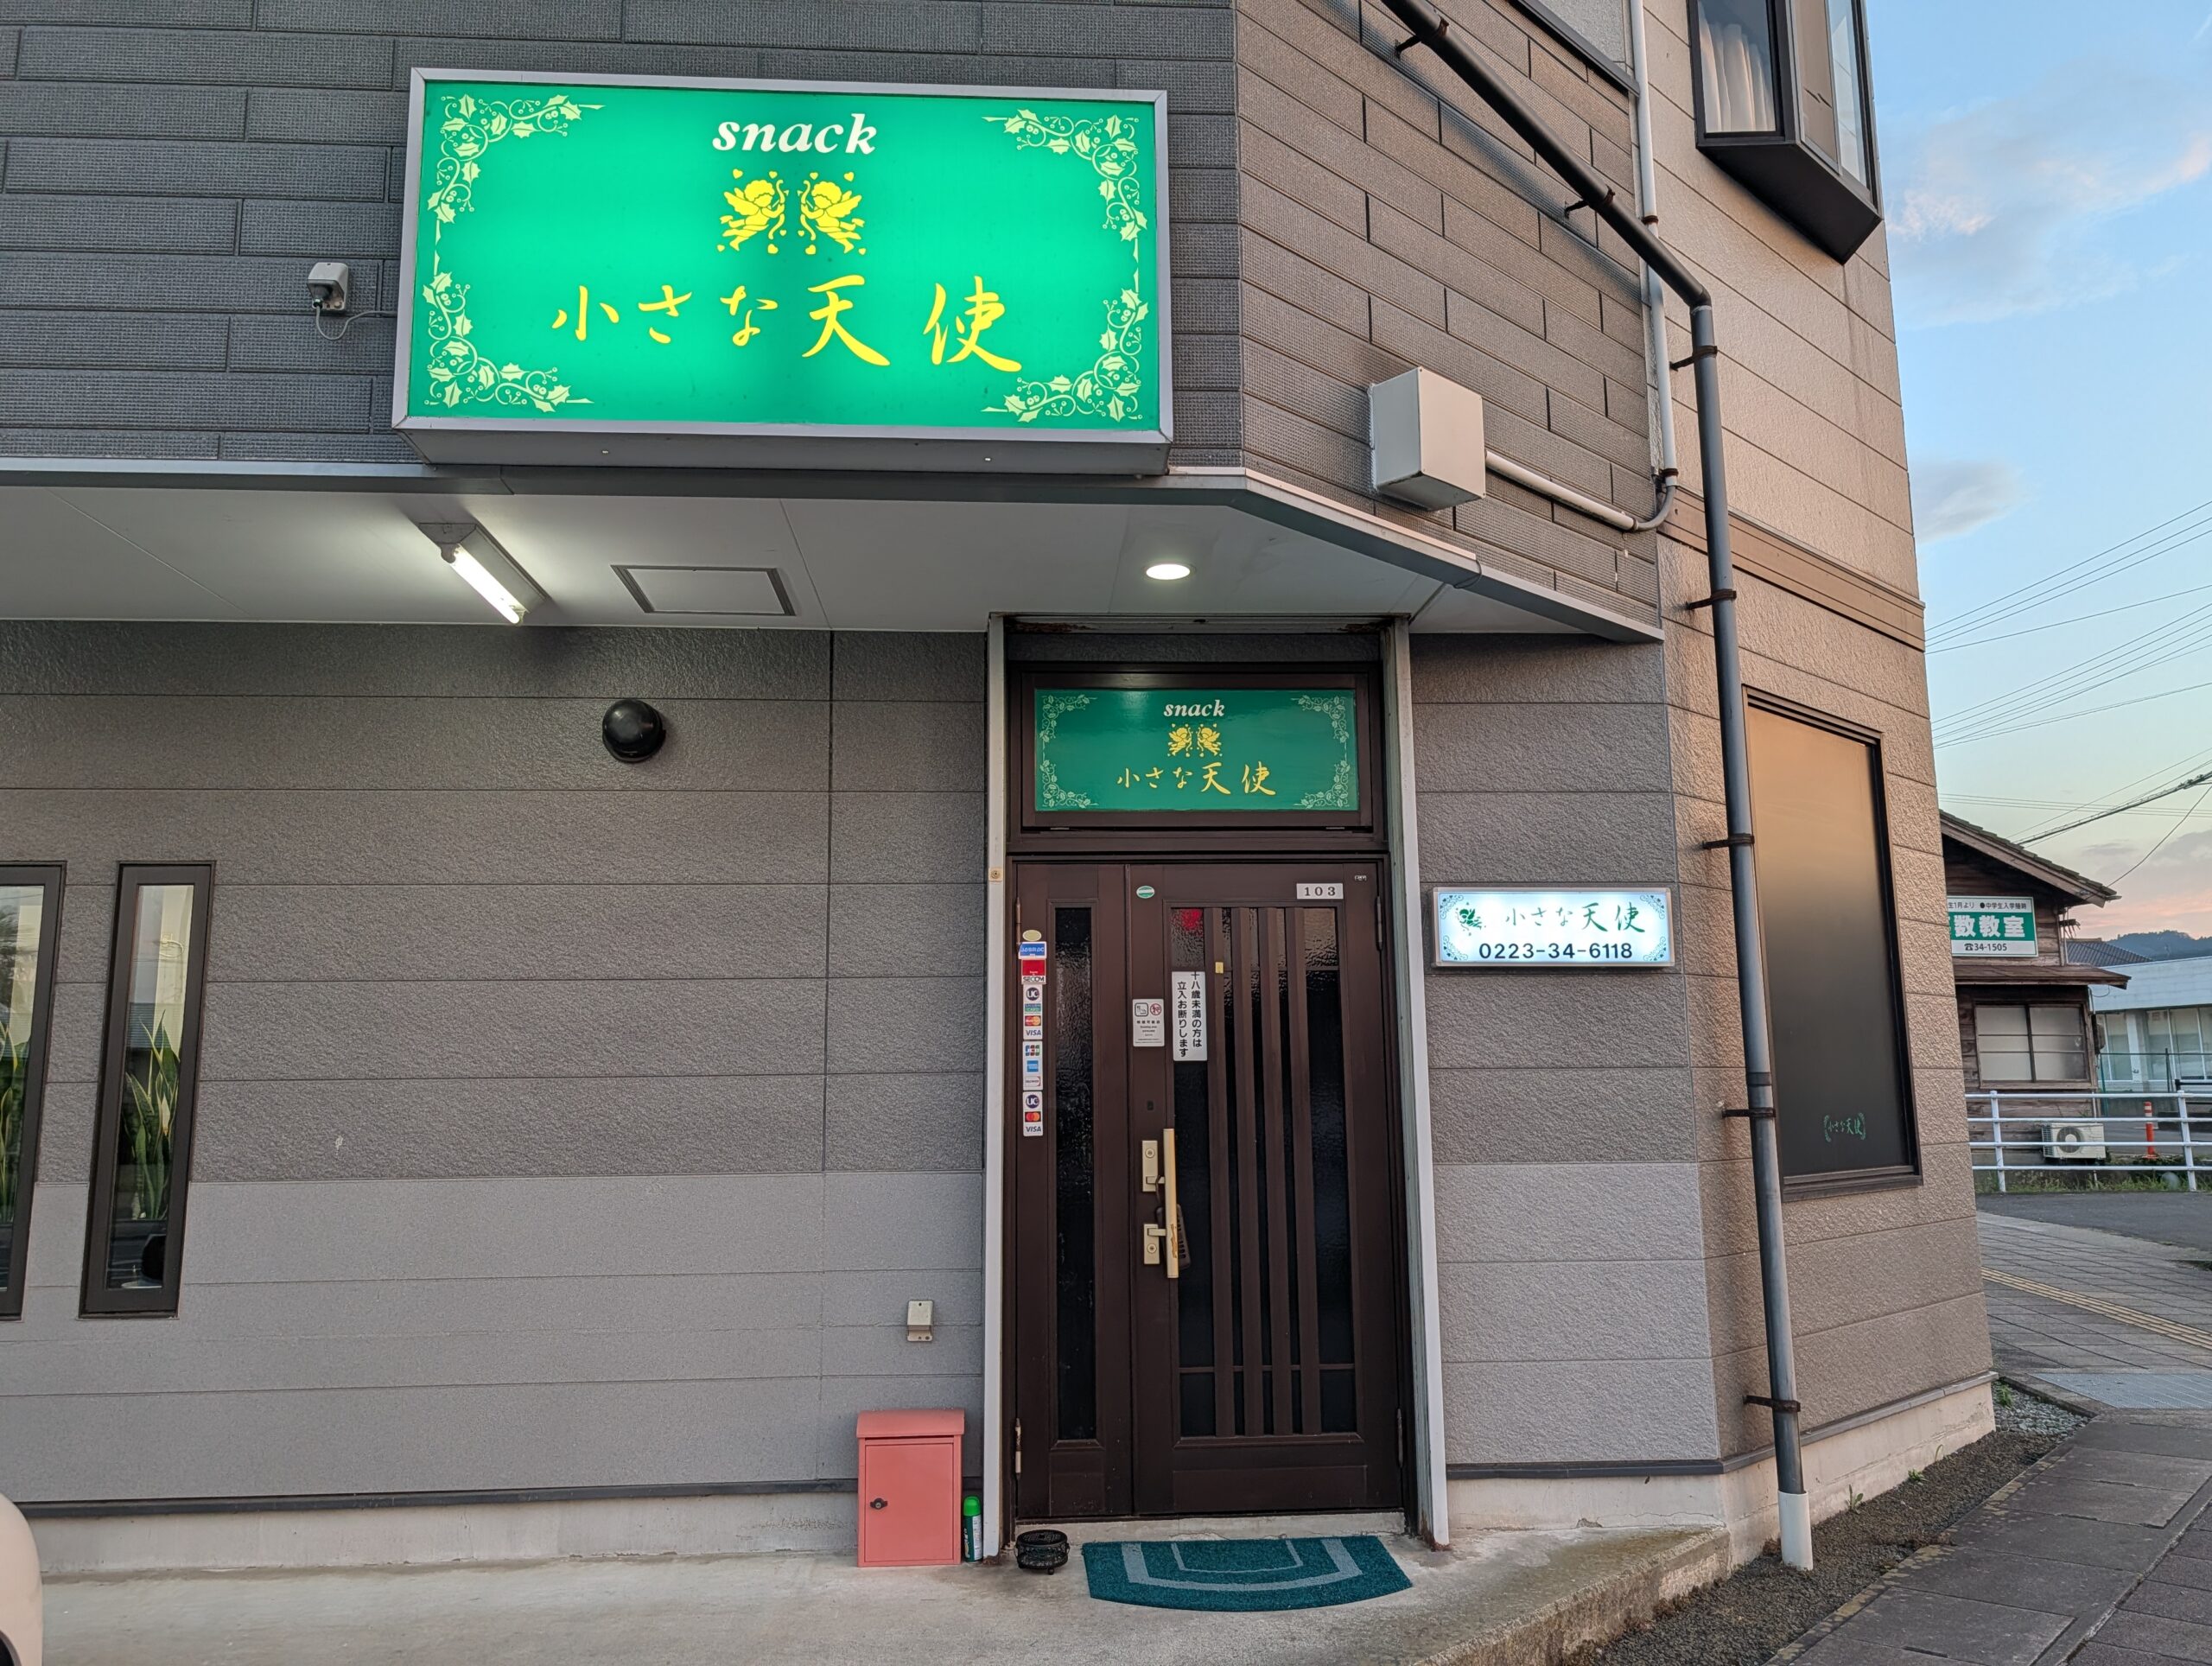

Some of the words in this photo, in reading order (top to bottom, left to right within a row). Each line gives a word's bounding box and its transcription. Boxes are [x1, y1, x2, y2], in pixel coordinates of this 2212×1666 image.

[712, 112, 876, 156] snack
[551, 274, 1023, 373] 小さな天使
[1163, 699, 1225, 718] snack
[1116, 761, 1276, 796] 小さな天使
[1304, 887, 1336, 896] 103
[1506, 902, 1645, 932] 小さな天使
[1948, 915, 2025, 938] 数教室
[1478, 943, 1633, 959] 0223-34-6118
[1177, 981, 1188, 1057] 立入お断りします
[1191, 971, 1202, 1047] 十八歳未満の方は
